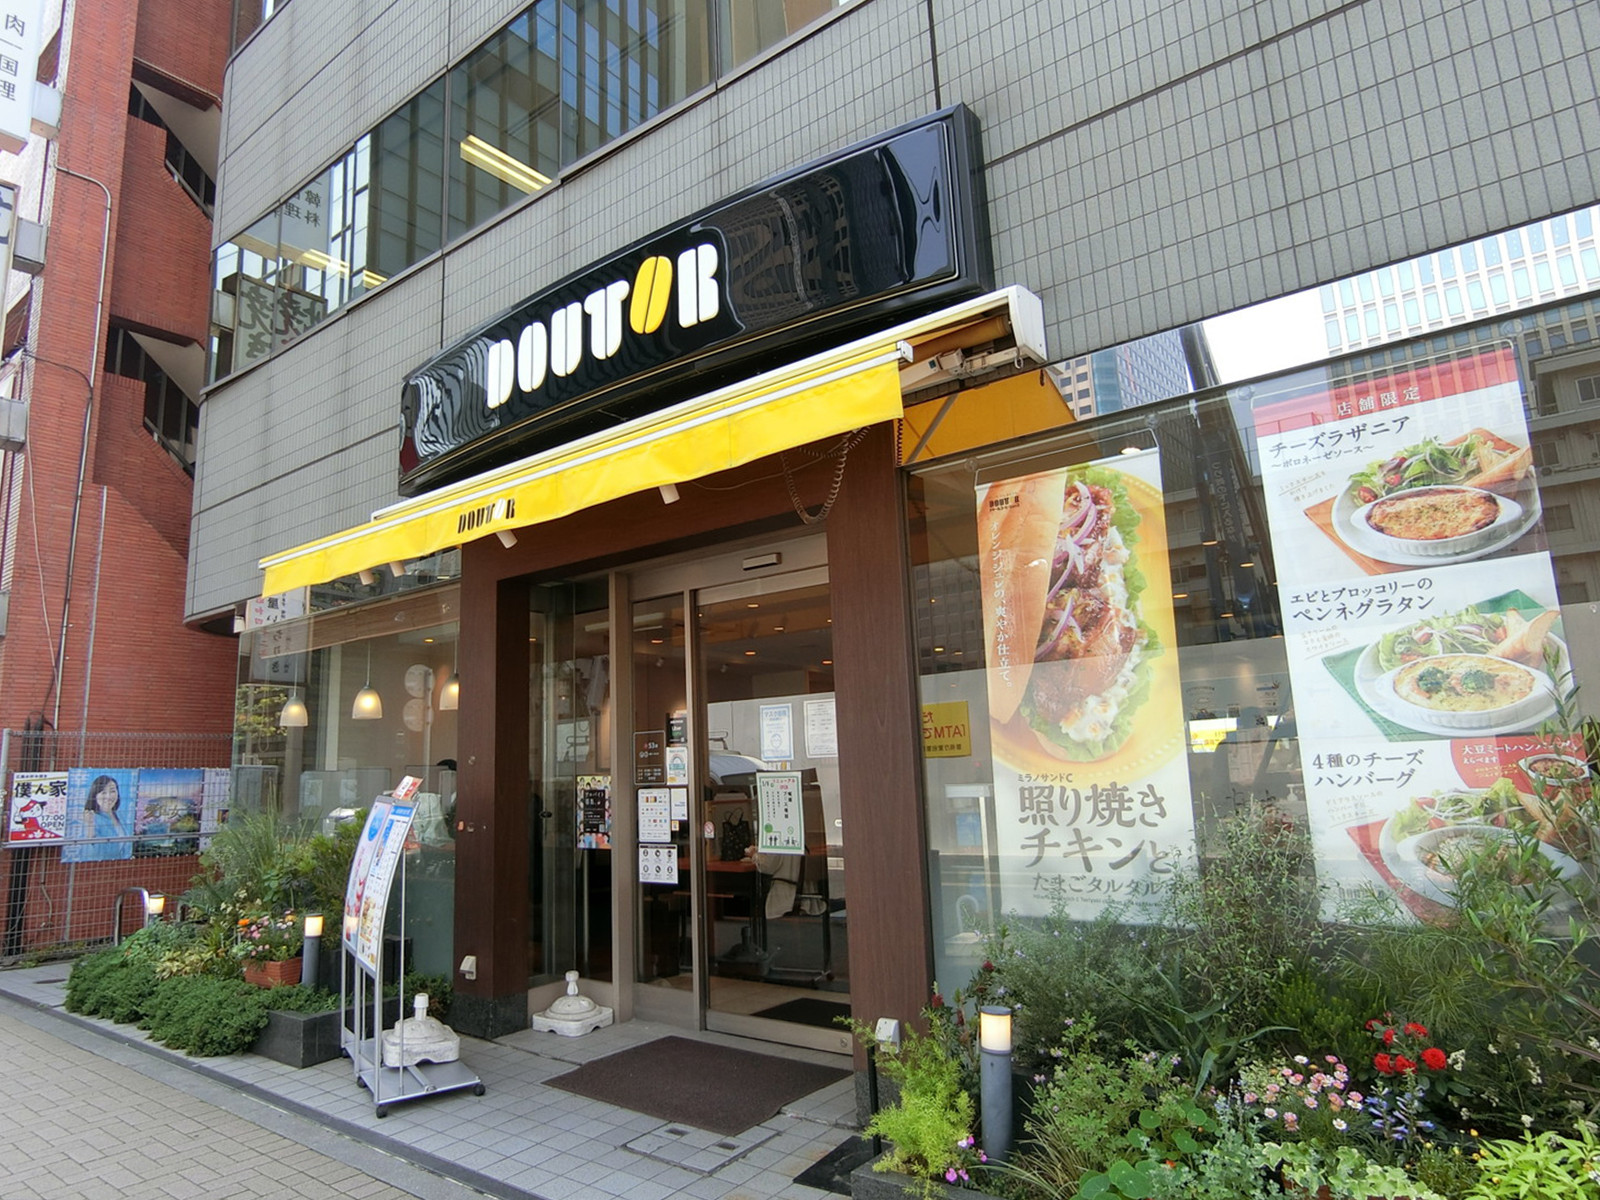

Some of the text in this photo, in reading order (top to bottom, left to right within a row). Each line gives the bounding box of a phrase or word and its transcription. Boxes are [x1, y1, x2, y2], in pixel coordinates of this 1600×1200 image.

[4, 14, 26, 38] 肉
[487, 243, 719, 410] DOUTOR
[1337, 387, 1421, 417] 店舗限定
[1269, 416, 1410, 459] チーズラザニア
[1290, 577, 1434, 605] エビとブロッコリーの
[1293, 595, 1436, 622] ペンネグラタン
[1312, 749, 1425, 770] 4種のチーズ
[14, 780, 67, 798] 僕ん家
[1017, 773, 1073, 783] ミラノサンドC
[1314, 768, 1416, 789] ハンバーグ
[1018, 781, 1167, 828] 照り焼き
[1020, 827, 1172, 874] チキンと
